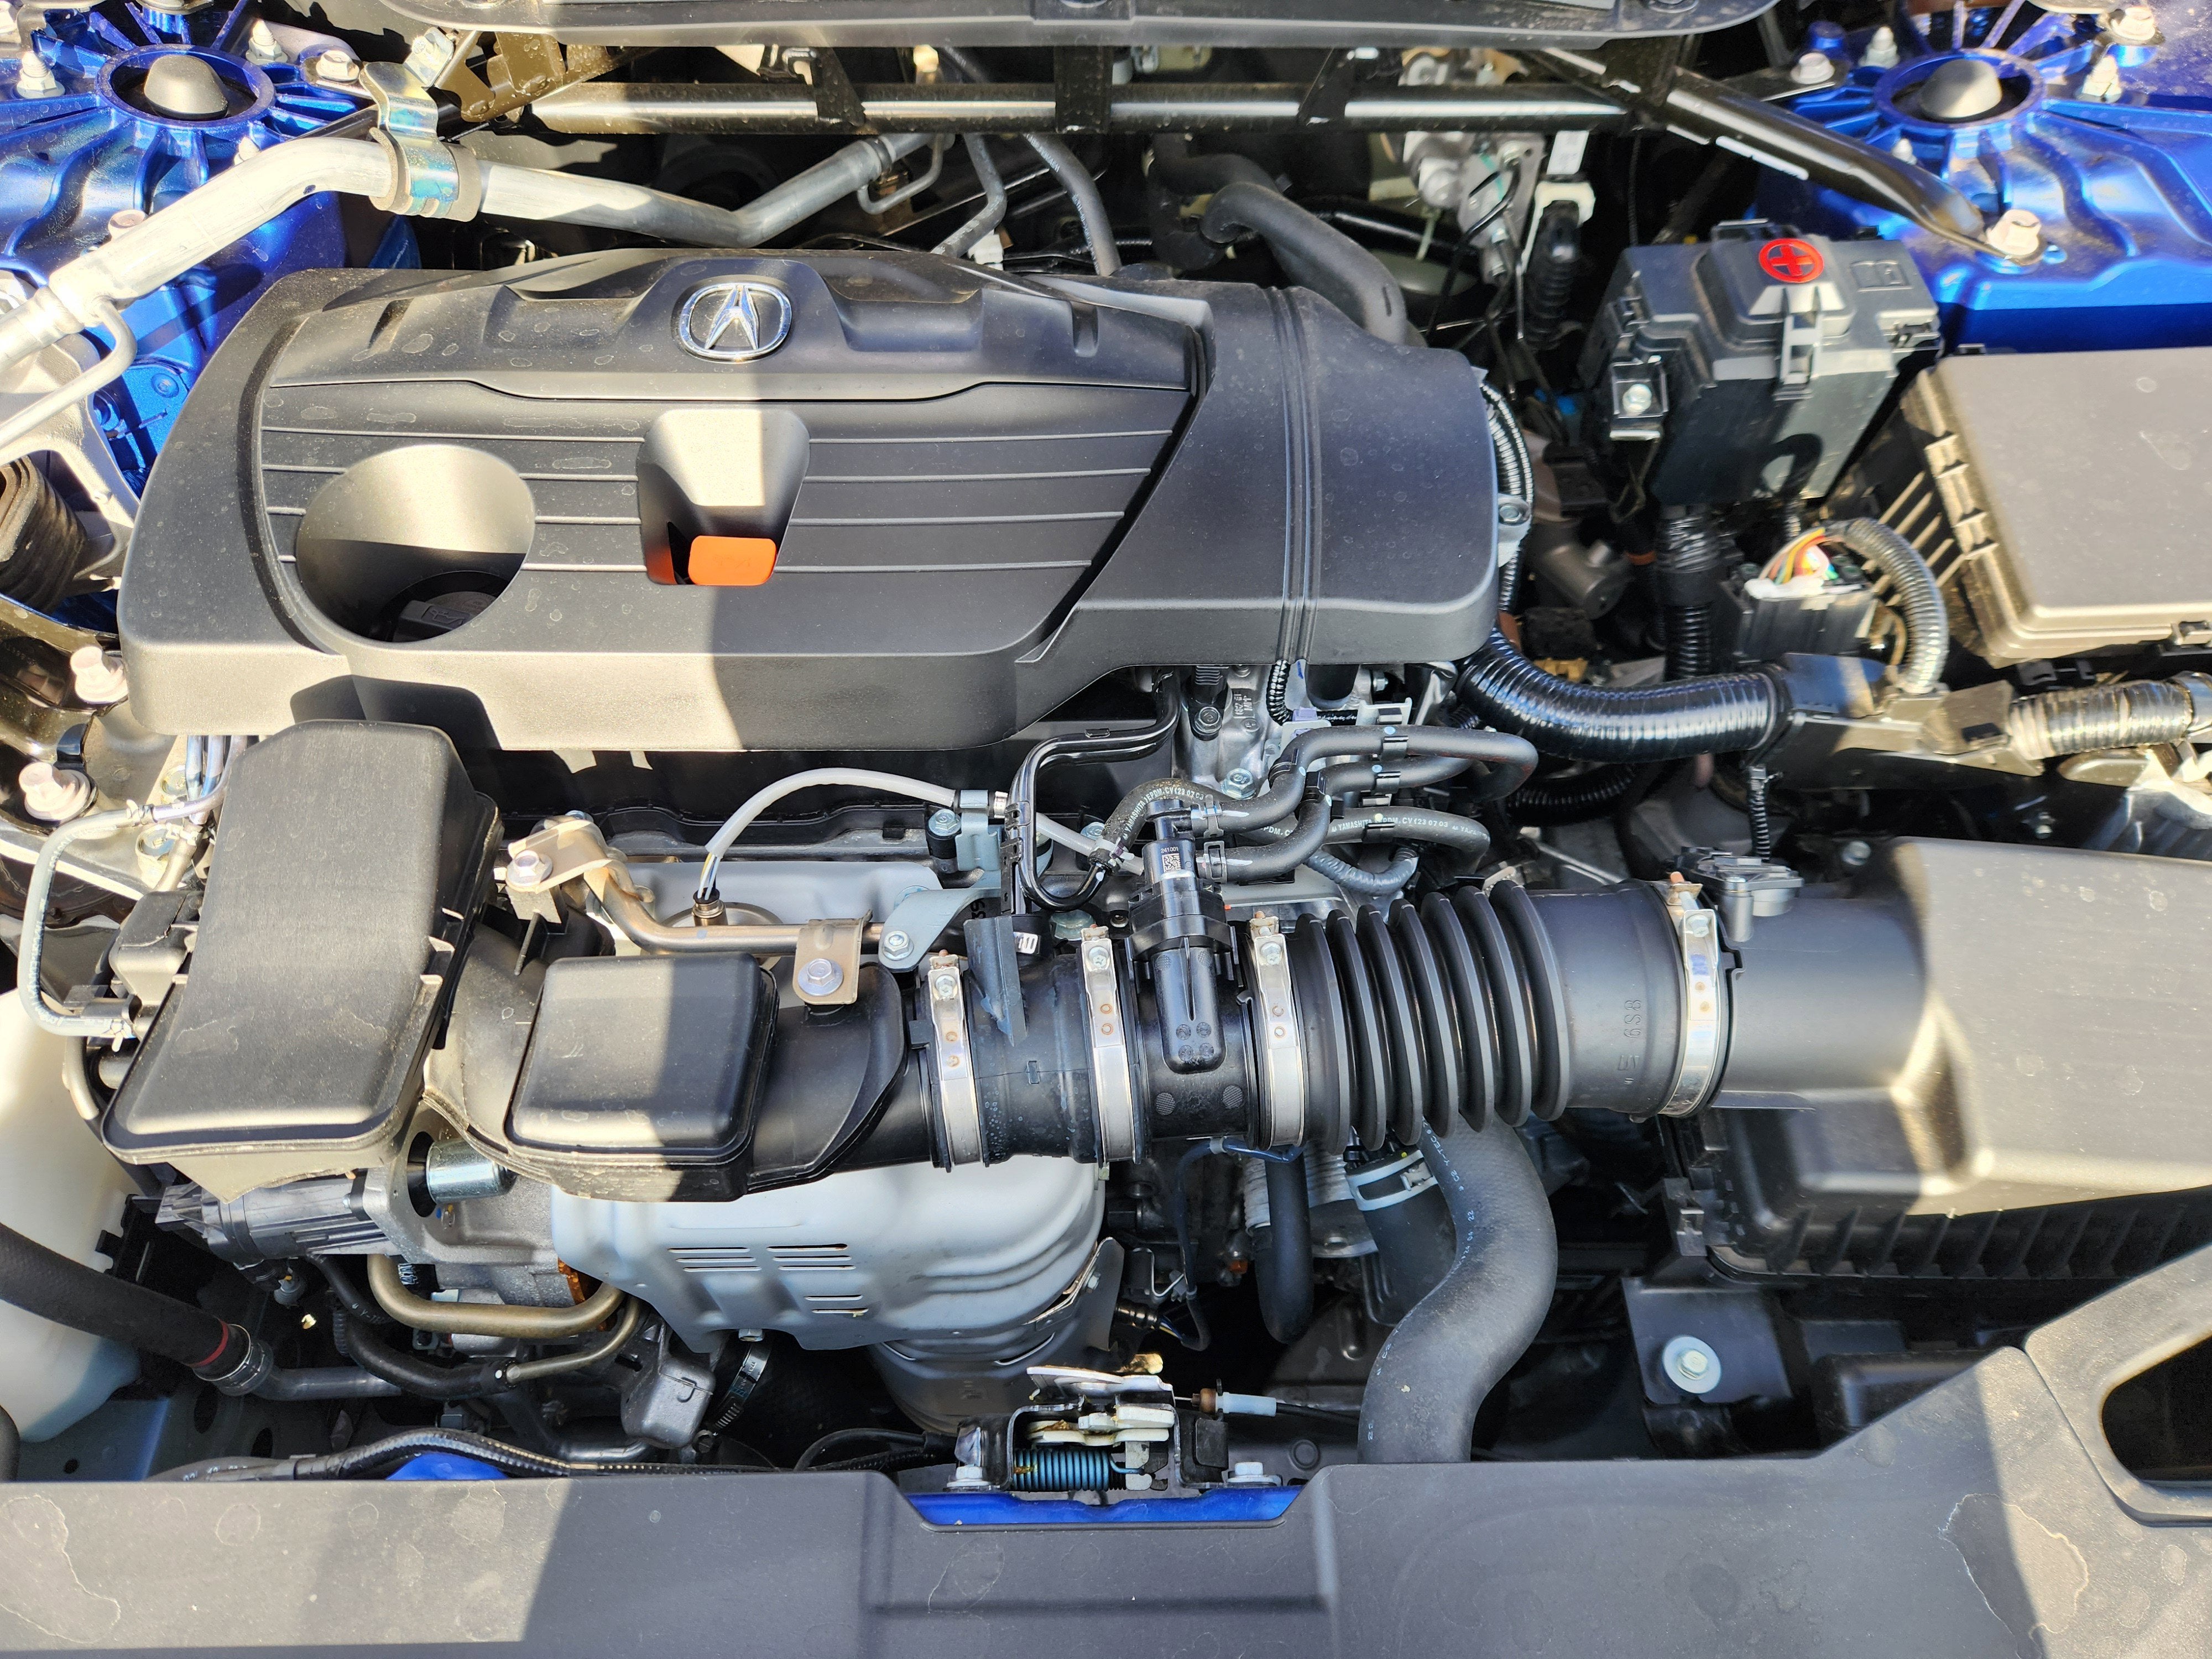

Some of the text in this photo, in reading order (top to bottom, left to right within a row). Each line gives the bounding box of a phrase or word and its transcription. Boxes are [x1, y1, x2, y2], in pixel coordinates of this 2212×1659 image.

[1124, 800, 1146, 833] YAMASHITA
[1338, 818, 1372, 831] YAMASHITA
[1624, 1000, 1641, 1038] 6S8
[1430, 1135, 1460, 1182] C2 Y-TEC
[1467, 1210, 1475, 1222] 22
